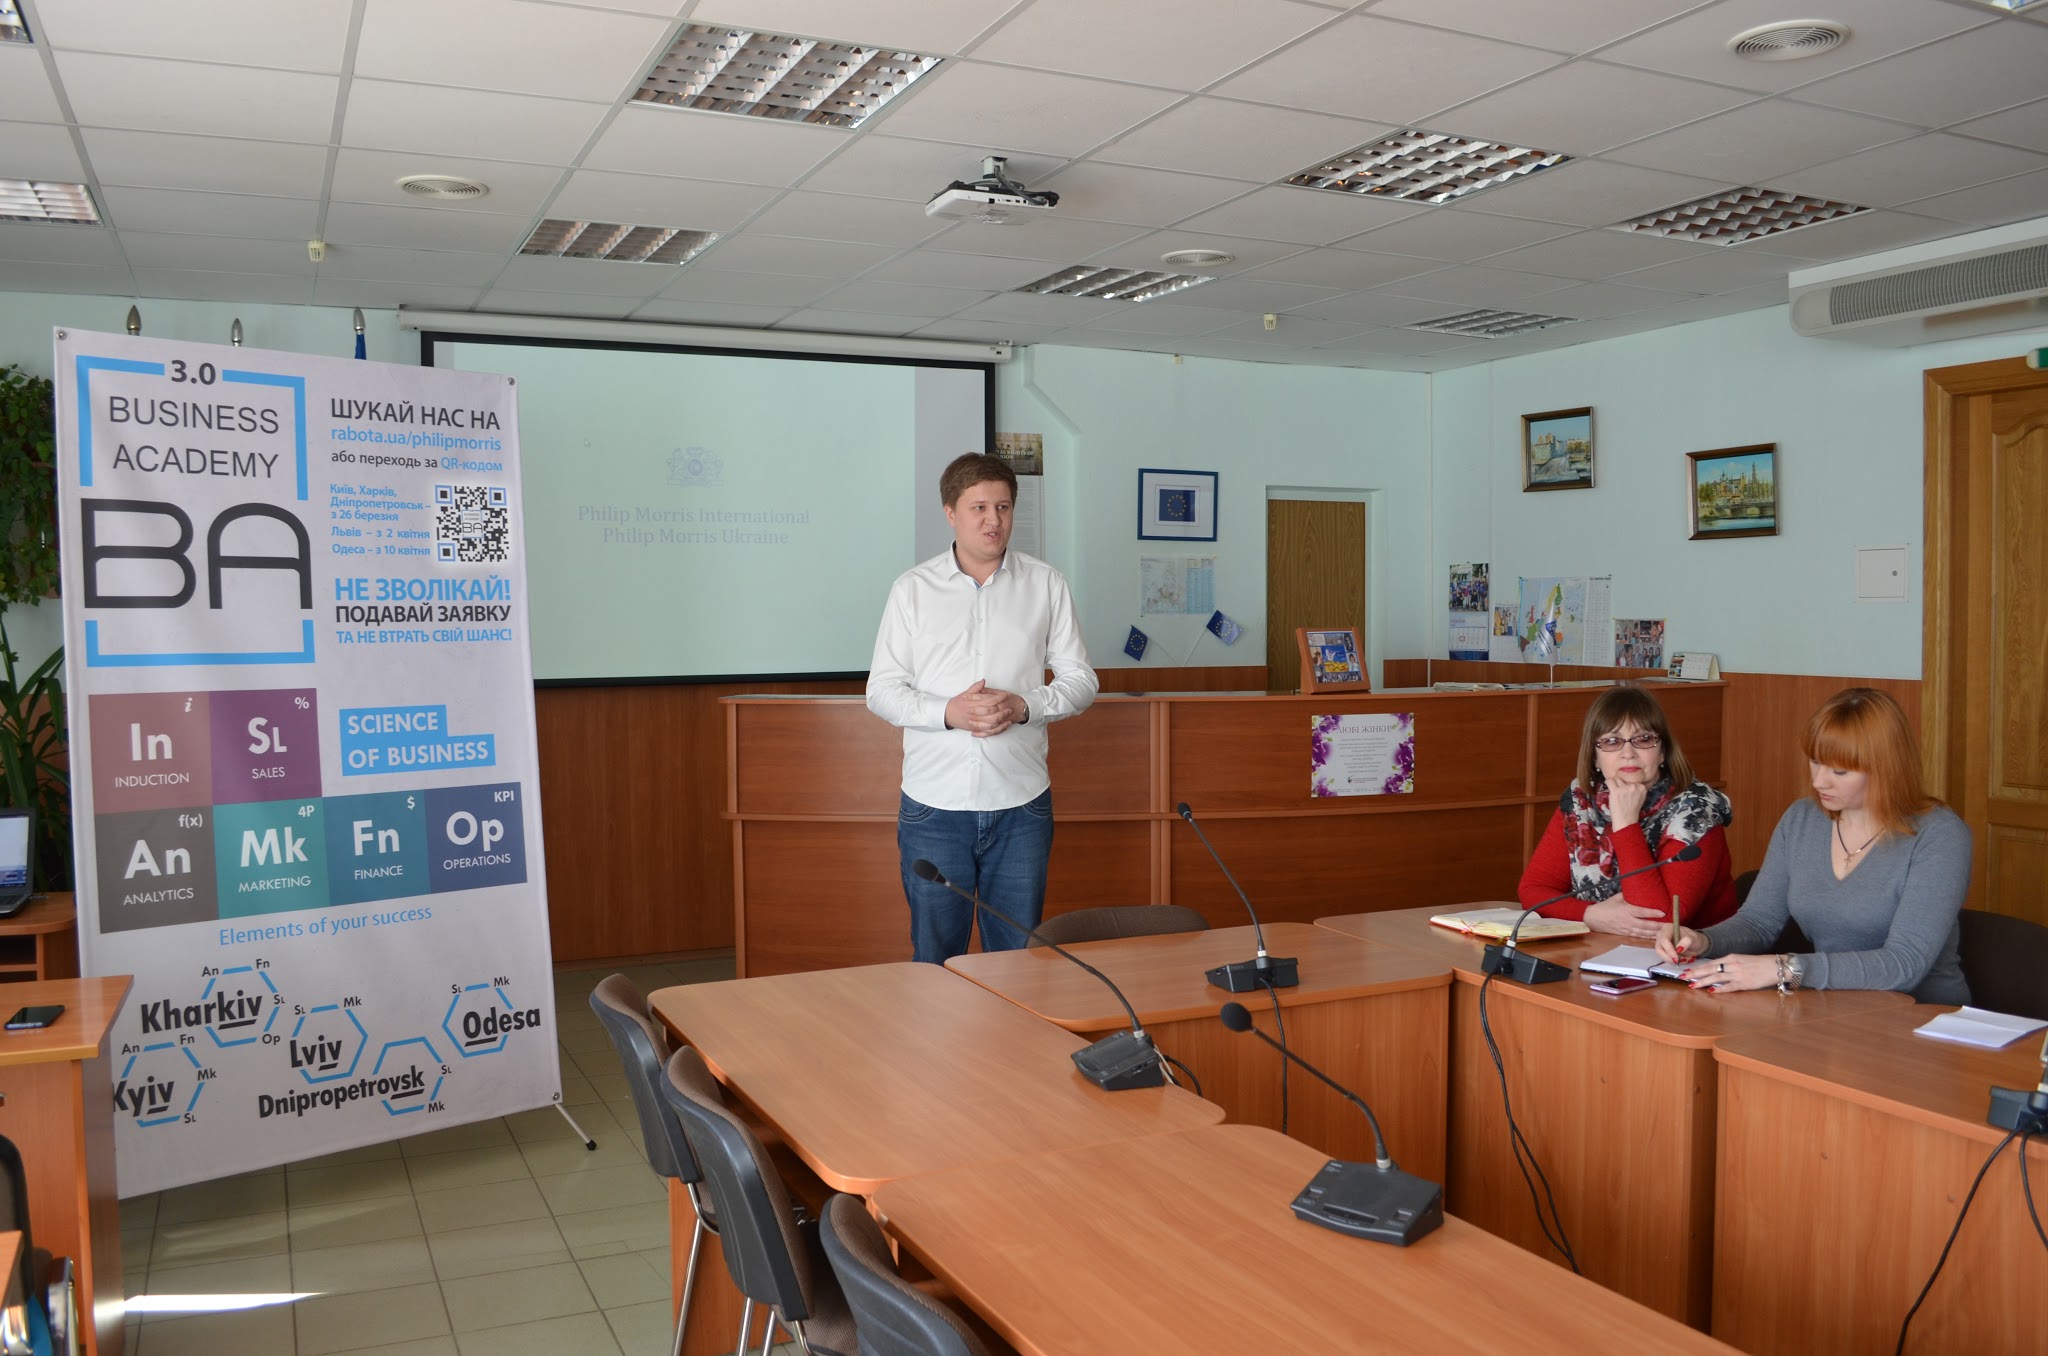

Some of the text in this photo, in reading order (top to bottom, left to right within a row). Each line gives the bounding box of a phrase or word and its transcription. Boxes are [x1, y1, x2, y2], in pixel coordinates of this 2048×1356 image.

[171, 359, 216, 386] 3.0
[109, 396, 280, 434] BUSINESS
[331, 398, 501, 430] ШУКАЙ НАС НА
[331, 426, 502, 451] rabota.ua/philipmorris
[113, 444, 279, 478] ACADEMY
[332, 450, 503, 473] або переходь за QR-кодом
[330, 483, 397, 498] Київ, Харків,
[330, 497, 423, 510] Дніпропетровськ
[331, 510, 398, 522] з 26 березня
[578, 505, 810, 526] Philip Morris International
[331, 527, 361, 537] Львів
[386, 529, 393, 538] 2
[397, 528, 430, 539] квітня
[603, 527, 789, 548] Philip Morris Ukraine
[80, 497, 313, 610] BA
[332, 543, 365, 555] Одеса
[376, 546, 382, 554] з
[384, 545, 396, 555] 10
[398, 545, 431, 556] квітня
[335, 575, 511, 601] НЕ ЗВОЛІКАЙ!
[336, 603, 511, 627] ПОДАВАЙ ЗАЯВКУ
[336, 627, 512, 644] ТА НЕ ВТРАТЬ СВІЙ ШАНС!
[184, 697, 193, 713] i
[348, 711, 439, 735] SCIENCE
[130, 723, 173, 761] In
[348, 740, 489, 769] OF BUSINESS
[115, 772, 190, 788] INDUCTION
[251, 766, 286, 780] SALES
[494, 790, 514, 803] KPI
[178, 813, 203, 828] f(x)
[298, 805, 315, 818] 4P
[352, 819, 400, 857] Fn
[446, 810, 505, 852] Op
[240, 826, 309, 868] Mk
[124, 839, 192, 880] An
[443, 853, 511, 871] OPERATIONS
[354, 865, 403, 881] FINANCE
[238, 875, 312, 893] MARKETING
[123, 887, 194, 906] ANALYTICS
[219, 906, 433, 946] Elements of your success
[201, 966, 220, 977] An
[256, 958, 270, 969] Fn
[493, 976, 510, 987] Mk
[140, 989, 263, 1034] Kharkiv
[343, 996, 362, 1008] Mk
[463, 1006, 541, 1039] Odesa
[180, 1034, 195, 1045] Fn
[262, 1033, 281, 1045] Op
[122, 1043, 140, 1055] An
[290, 1034, 342, 1068] Lviv
[197, 1068, 217, 1081] Mk
[113, 1075, 175, 1118] Kyiv
[258, 1065, 425, 1118] Dnipropetrovsk
[428, 1100, 445, 1113] Mk
